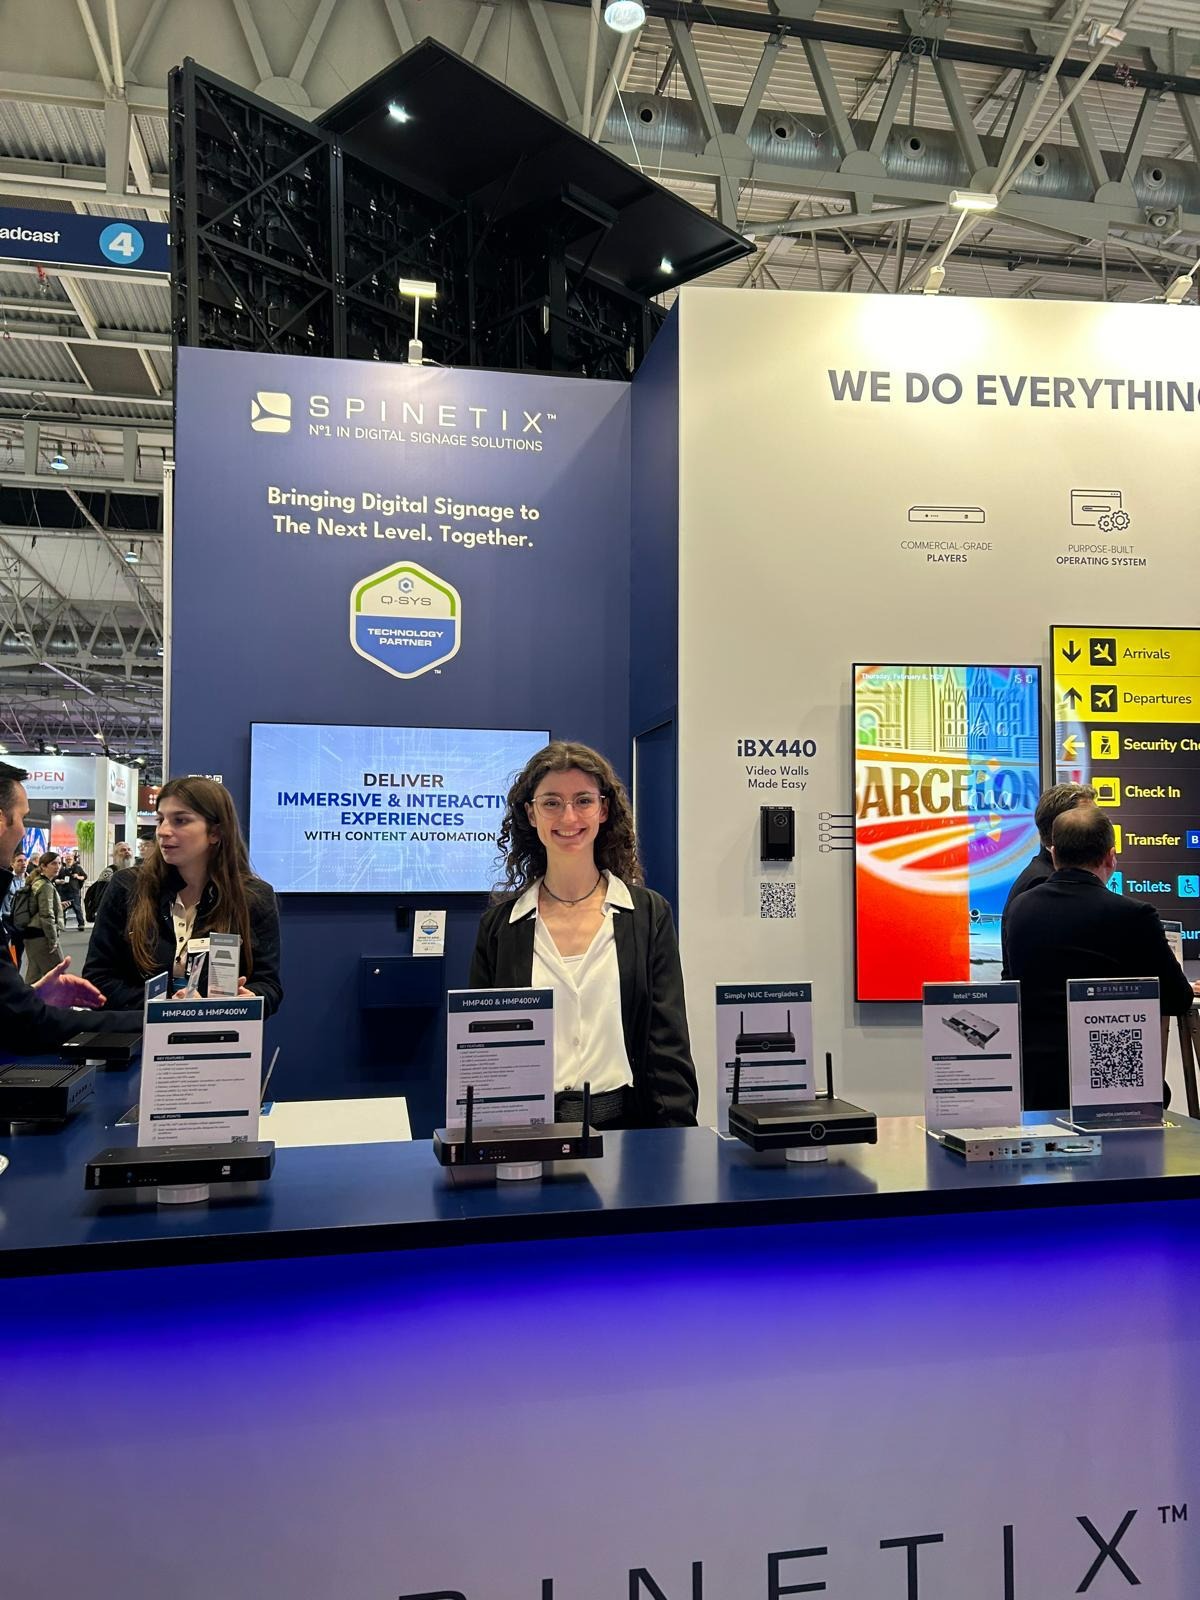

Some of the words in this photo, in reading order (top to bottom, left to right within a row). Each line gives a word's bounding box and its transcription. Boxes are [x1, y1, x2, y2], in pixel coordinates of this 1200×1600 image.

[109, 232, 134, 256] 4
[827, 369, 891, 402] WE
[905, 372, 963, 405] DO
[977, 374, 1200, 412] EVERYTHIN
[309, 395, 542, 433] SPINETIX
[336, 426, 350, 438] IN
[355, 427, 405, 442] DIGITAL
[410, 431, 467, 446] SIGNAGE
[471, 436, 542, 451] SOLUTIONS
[267, 486, 355, 513] Bringing
[362, 492, 428, 516] Digital
[434, 497, 514, 523] Signage
[519, 504, 540, 520] to
[273, 515, 311, 535] The
[317, 517, 367, 538] Next
[374, 521, 432, 542] Level.
[439, 524, 534, 548] Together.
[900, 540, 993, 551] COMMERCIAL-GRADE
[1068, 543, 1135, 554] PURPOSE-BUILT
[927, 554, 968, 563] PLAYERS
[1056, 556, 1109, 566] OPERATING
[1111, 557, 1147, 567] SYSTEM
[380, 595, 432, 606] Q-SYS
[367, 628, 444, 638] TECHNOLOGY
[379, 638, 432, 647] PARTNER
[1122, 648, 1171, 660] Arrivals
[1123, 692, 1192, 706] Departures
[737, 739, 817, 758] iBX440
[1124, 738, 1177, 753] Security
[745, 766, 777, 776] Video
[780, 766, 809, 776] Walls
[363, 773, 444, 788] DELIVER
[748, 779, 778, 789] Made
[781, 779, 807, 791] Easy
[1125, 785, 1165, 798] Check
[1168, 786, 1181, 798] In
[277, 791, 382, 807] IMMERSIVE
[387, 793, 401, 808] &
[341, 811, 464, 826] EXPERIENCES
[304, 831, 341, 841] WITH
[345, 831, 407, 841] CONTENT
[410, 831, 496, 842] AUTOMATION
[1125, 833, 1181, 846] Transfer
[1191, 835, 1199, 844] B
[1126, 880, 1172, 893] Toilets
[462, 999, 494, 1007] HMP400
[502, 997, 540, 1005] HMP400W
[162, 1009, 196, 1017] HMP400
[205, 1008, 248, 1016] HMP400W
[1084, 1014, 1130, 1024] CONTACT
[1133, 1014, 1146, 1022] US
